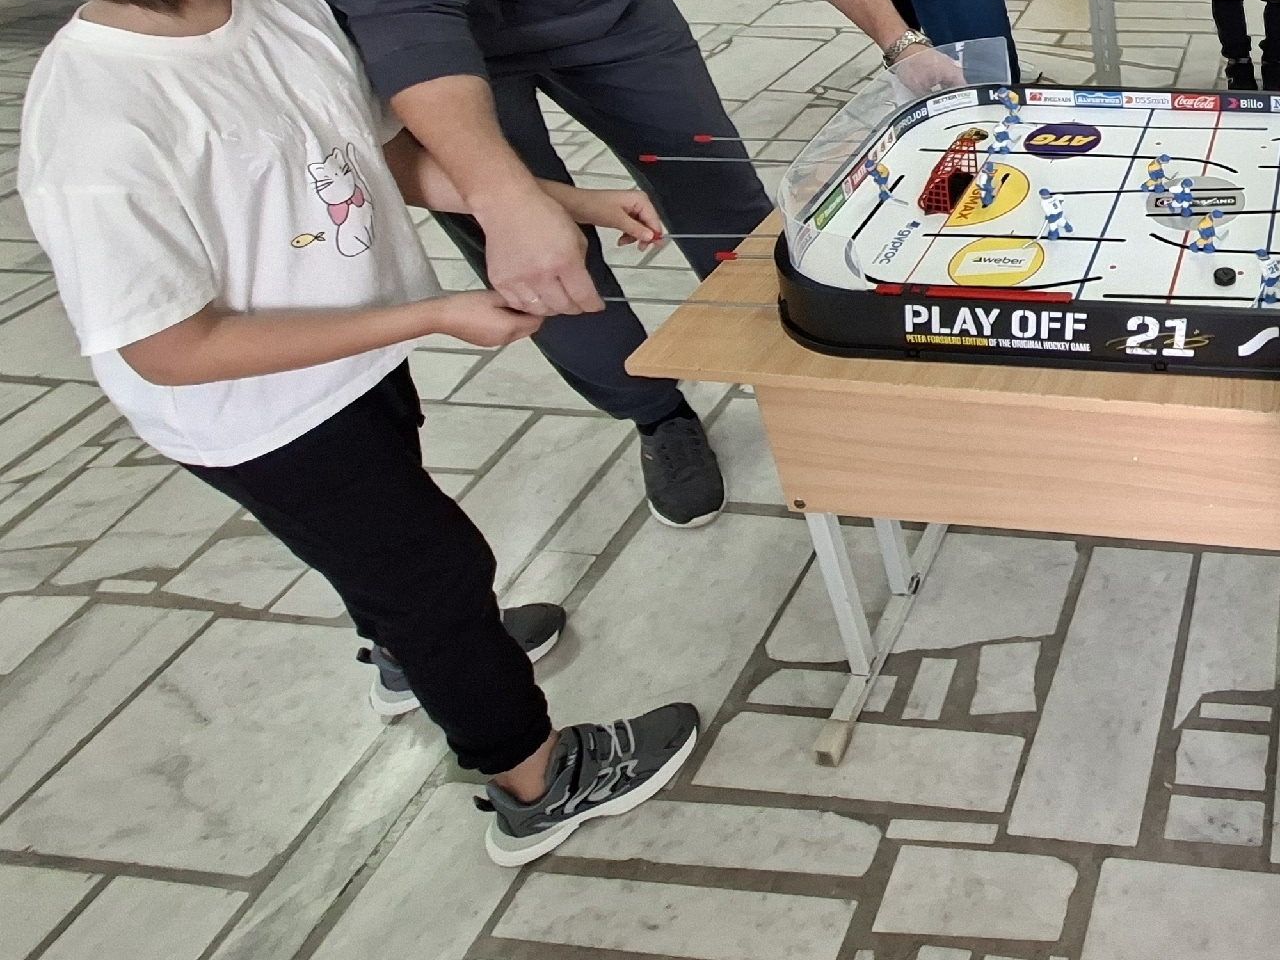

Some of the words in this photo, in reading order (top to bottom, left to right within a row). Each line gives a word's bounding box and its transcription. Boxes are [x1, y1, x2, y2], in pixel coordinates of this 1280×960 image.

[1240, 99, 1263, 109] Billo
[1031, 133, 1097, 146] ATG
[981, 256, 1026, 266] weber
[904, 304, 1000, 336] PLAY
[1011, 309, 1088, 340] OFF
[1125, 315, 1195, 357] 21
[962, 337, 988, 347] EDITION
[988, 338, 997, 347] OF
[997, 338, 1012, 348] THE
[1011, 339, 1043, 350] ORIGINAL
[1043, 341, 1070, 351] HOCKEY
[1070, 342, 1092, 352] GAME
